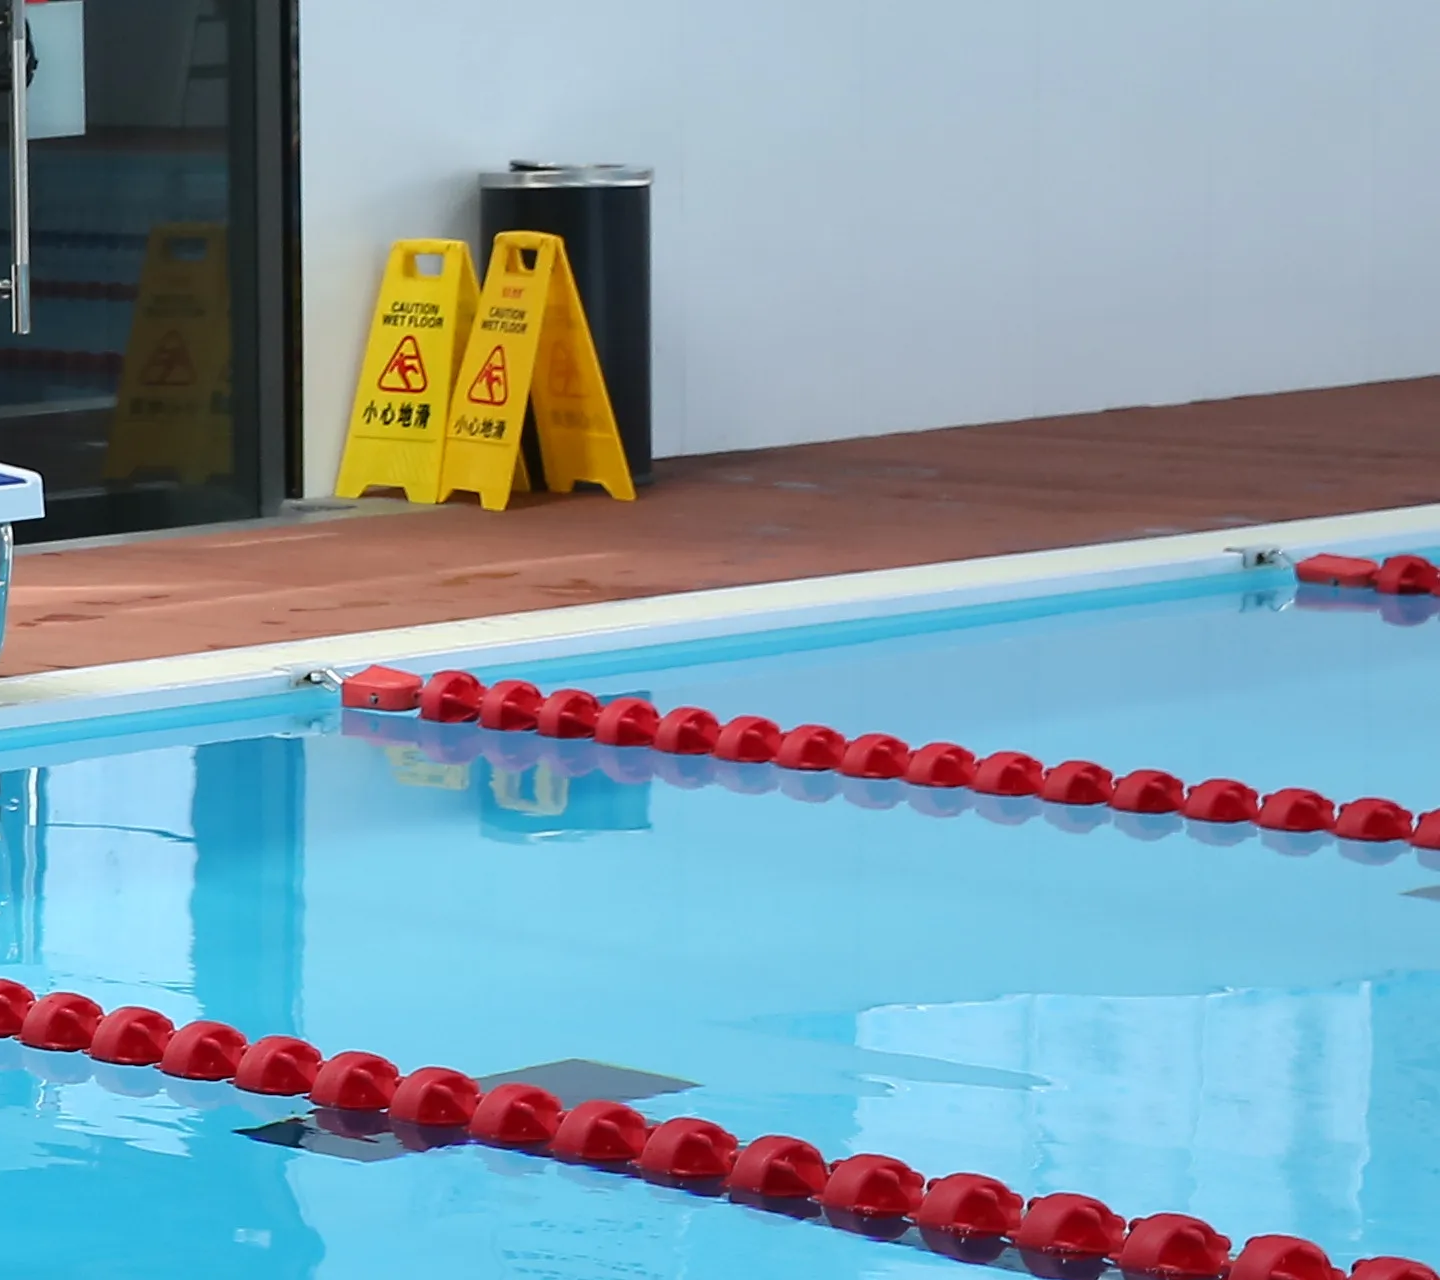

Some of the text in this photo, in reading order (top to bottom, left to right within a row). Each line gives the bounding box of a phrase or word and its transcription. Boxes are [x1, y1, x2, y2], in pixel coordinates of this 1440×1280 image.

[391, 301, 440, 314] CAUTION
[489, 306, 526, 320] CAUTION
[382, 314, 444, 329] WET FLOOR
[481, 320, 527, 334] WET FLOOR
[361, 401, 431, 429] 小心地滑
[454, 415, 506, 439] 小心地滑
